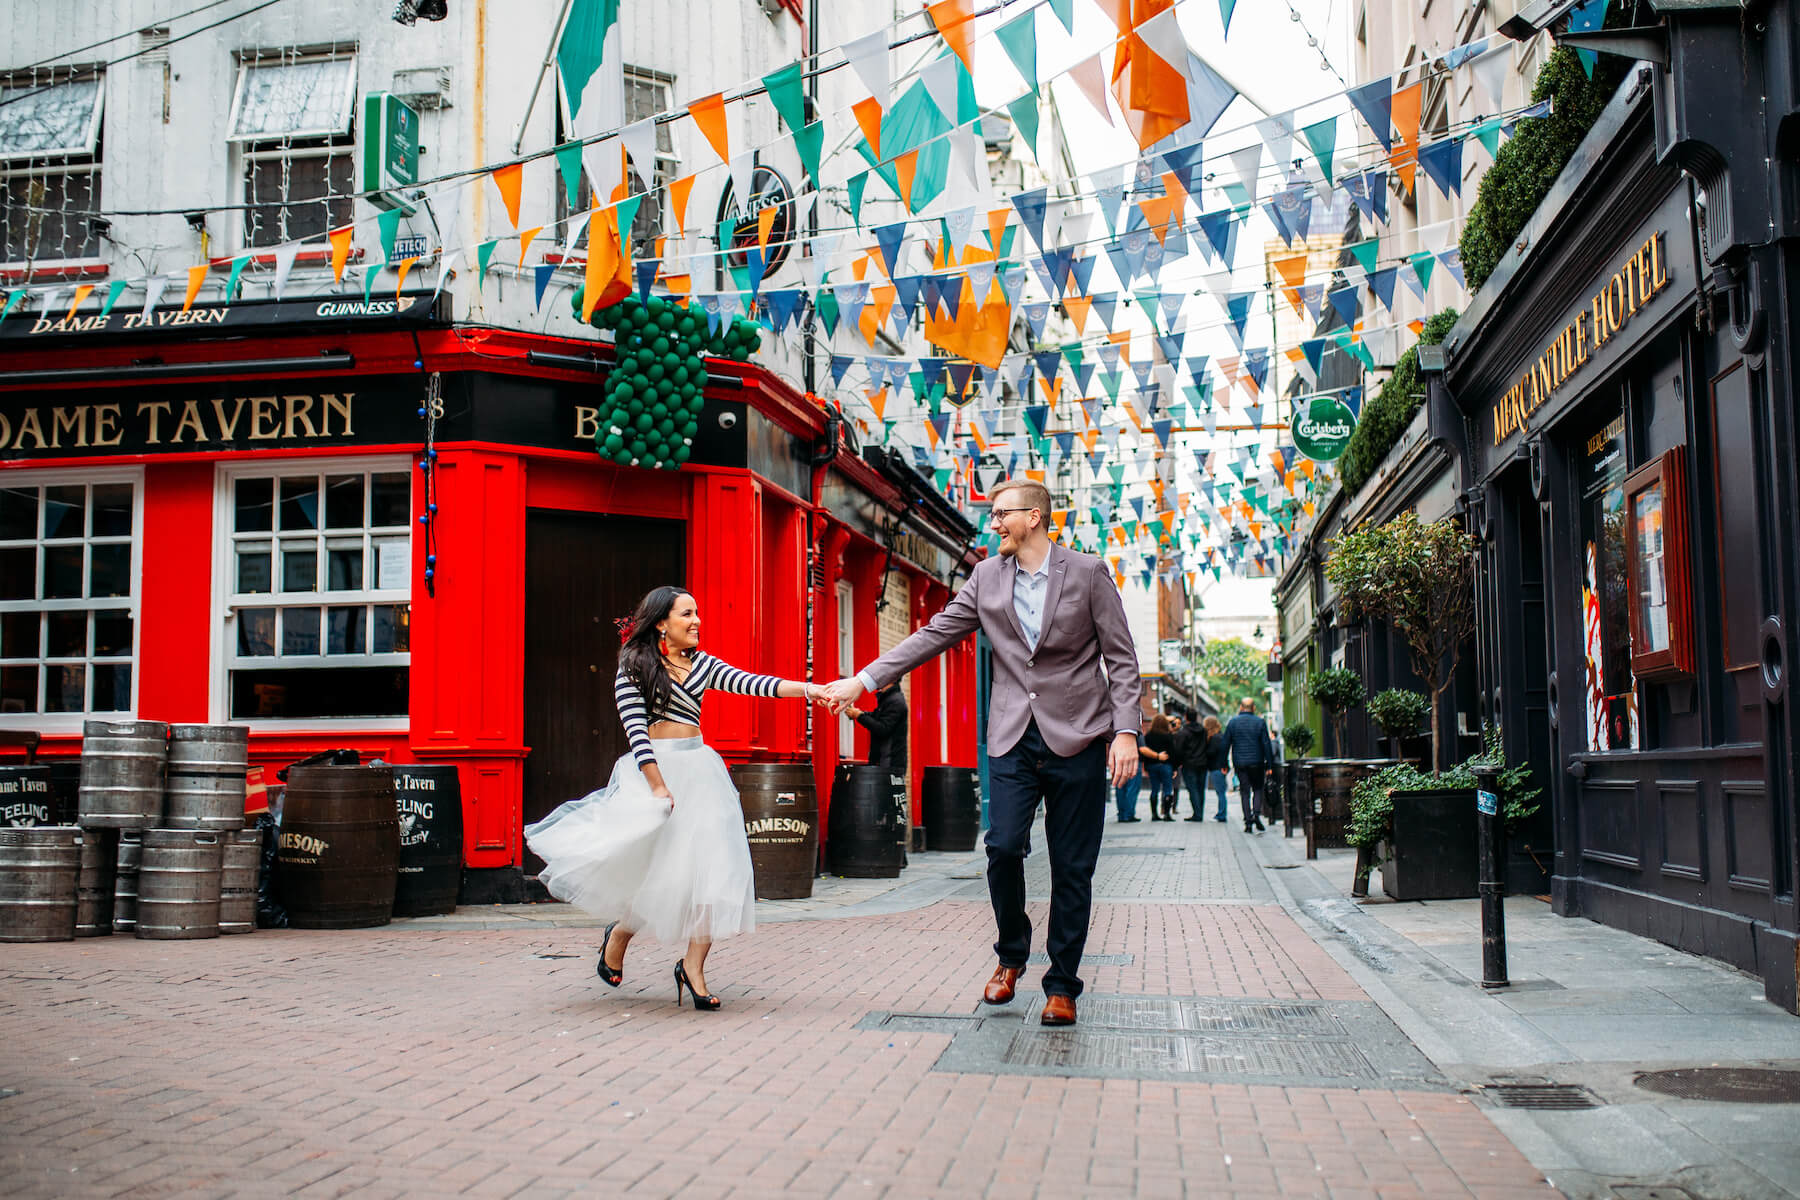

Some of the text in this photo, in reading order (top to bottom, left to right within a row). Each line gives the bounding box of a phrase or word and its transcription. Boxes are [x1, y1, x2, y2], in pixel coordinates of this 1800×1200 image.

[392, 237, 425, 255] YETECH
[316, 301, 395, 317] GUINNESS
[30, 308, 230, 334] DAME TAVERN
[1493, 230, 1667, 447] MERCANTILE HOTEL
[136, 393, 356, 444] TAVERN
[1298, 419, 1350, 441] Carlsberg
[20, 776, 48, 793] Tavern
[403, 774, 436, 791] Tavern
[745, 817, 809, 836] JAMESON
